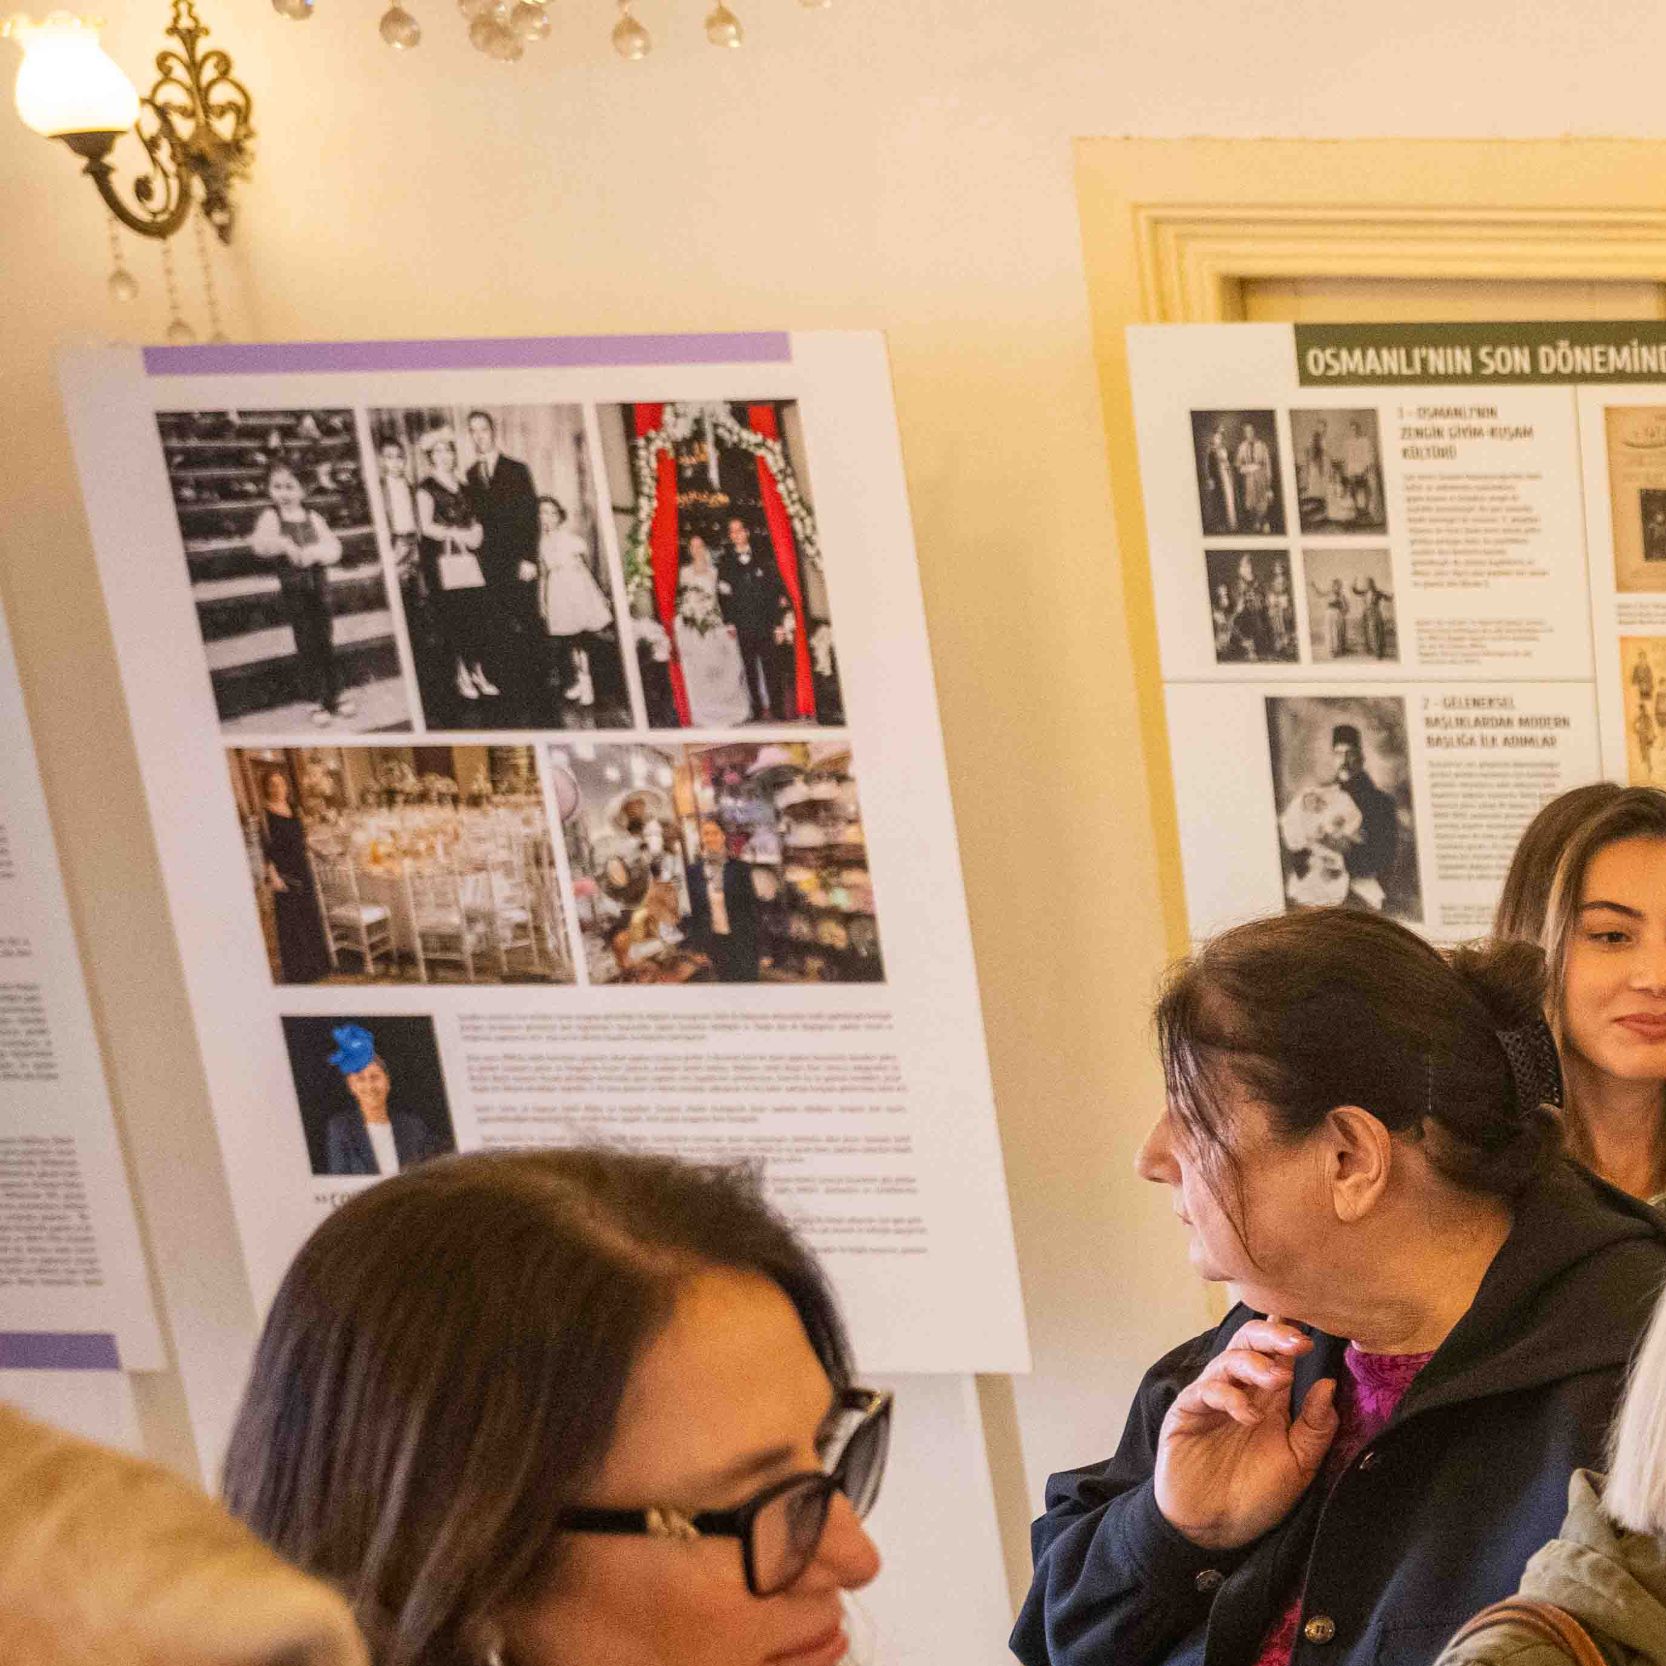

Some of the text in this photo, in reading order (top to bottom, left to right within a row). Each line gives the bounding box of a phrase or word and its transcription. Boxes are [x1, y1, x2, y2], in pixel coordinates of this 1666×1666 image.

[1306, 342, 1473, 377] OSMANLI'NIN
[1480, 343, 1532, 376] SON
[1518, 716, 1570, 728] MODERN
